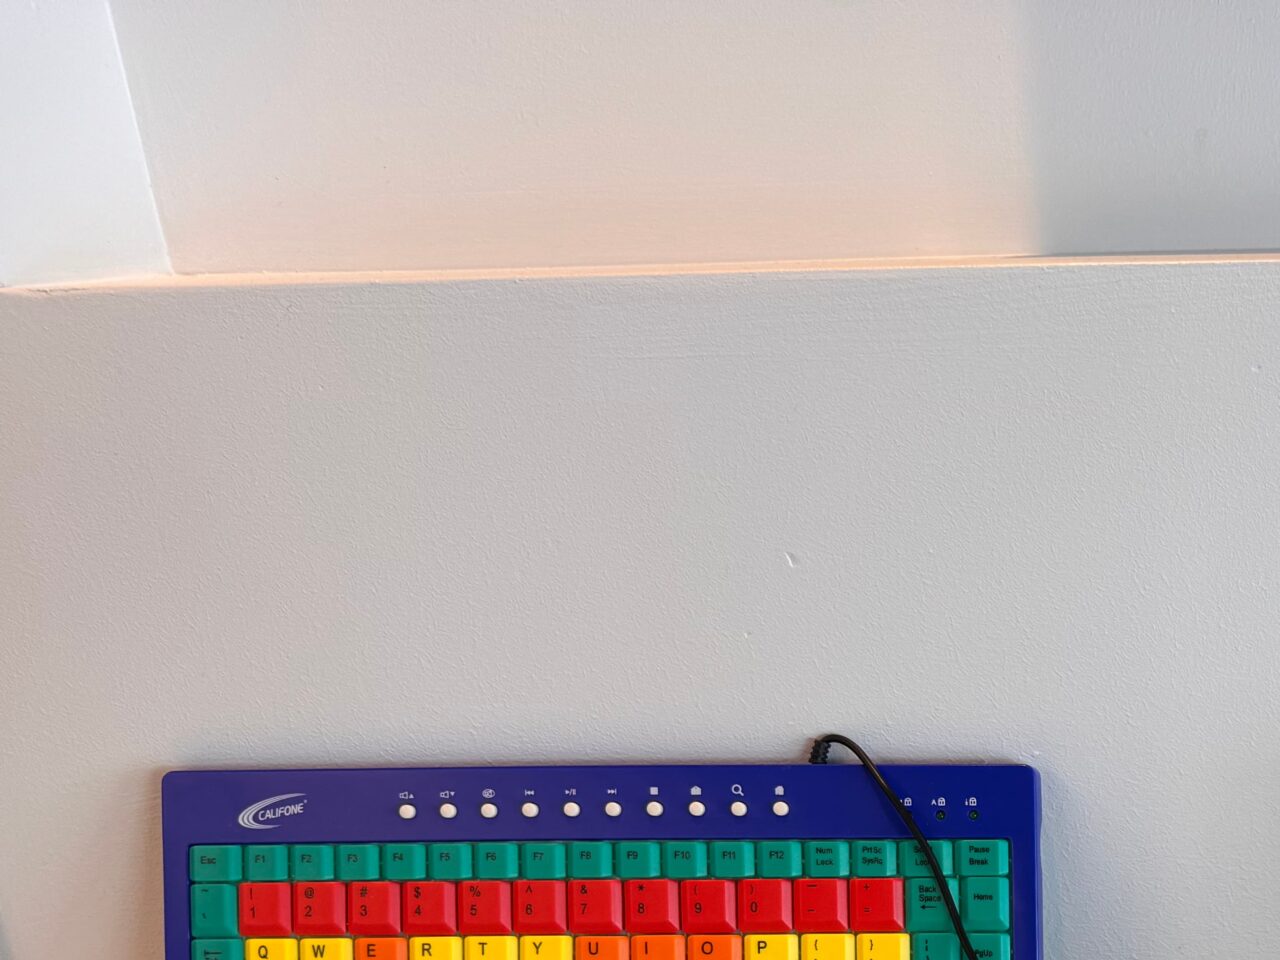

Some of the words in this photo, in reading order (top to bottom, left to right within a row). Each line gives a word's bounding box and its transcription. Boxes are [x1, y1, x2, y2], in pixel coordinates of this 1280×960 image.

[258, 802, 304, 821] CALIFONE
[200, 856, 216, 864] Esc
[255, 855, 265, 863] F1
[301, 854, 311, 863] F2
[348, 854, 357, 862] F3
[393, 853, 403, 861] F4
[440, 853, 450, 861] F5
[533, 852, 544, 860] F7
[580, 851, 591, 859] F8
[627, 851, 638, 859] F9
[674, 850, 690, 860] F10
[722, 851, 735, 859] F11
[769, 851, 784, 859] F12
[304, 887, 314, 899] @
[414, 887, 421, 898] $
[305, 905, 312, 917] 2
[360, 905, 367, 916] 3
[470, 905, 477, 916] 5
[695, 903, 702, 913] 9
[750, 901, 758, 912] 0
[258, 945, 268, 959] Q
[312, 945, 325, 958] W
[367, 944, 376, 957] E
[422, 943, 431, 956] R
[478, 942, 487, 955] T
[533, 942, 542, 954] Y
[589, 942, 598, 955] U
[701, 941, 713, 955] O
[758, 941, 767, 953] P
